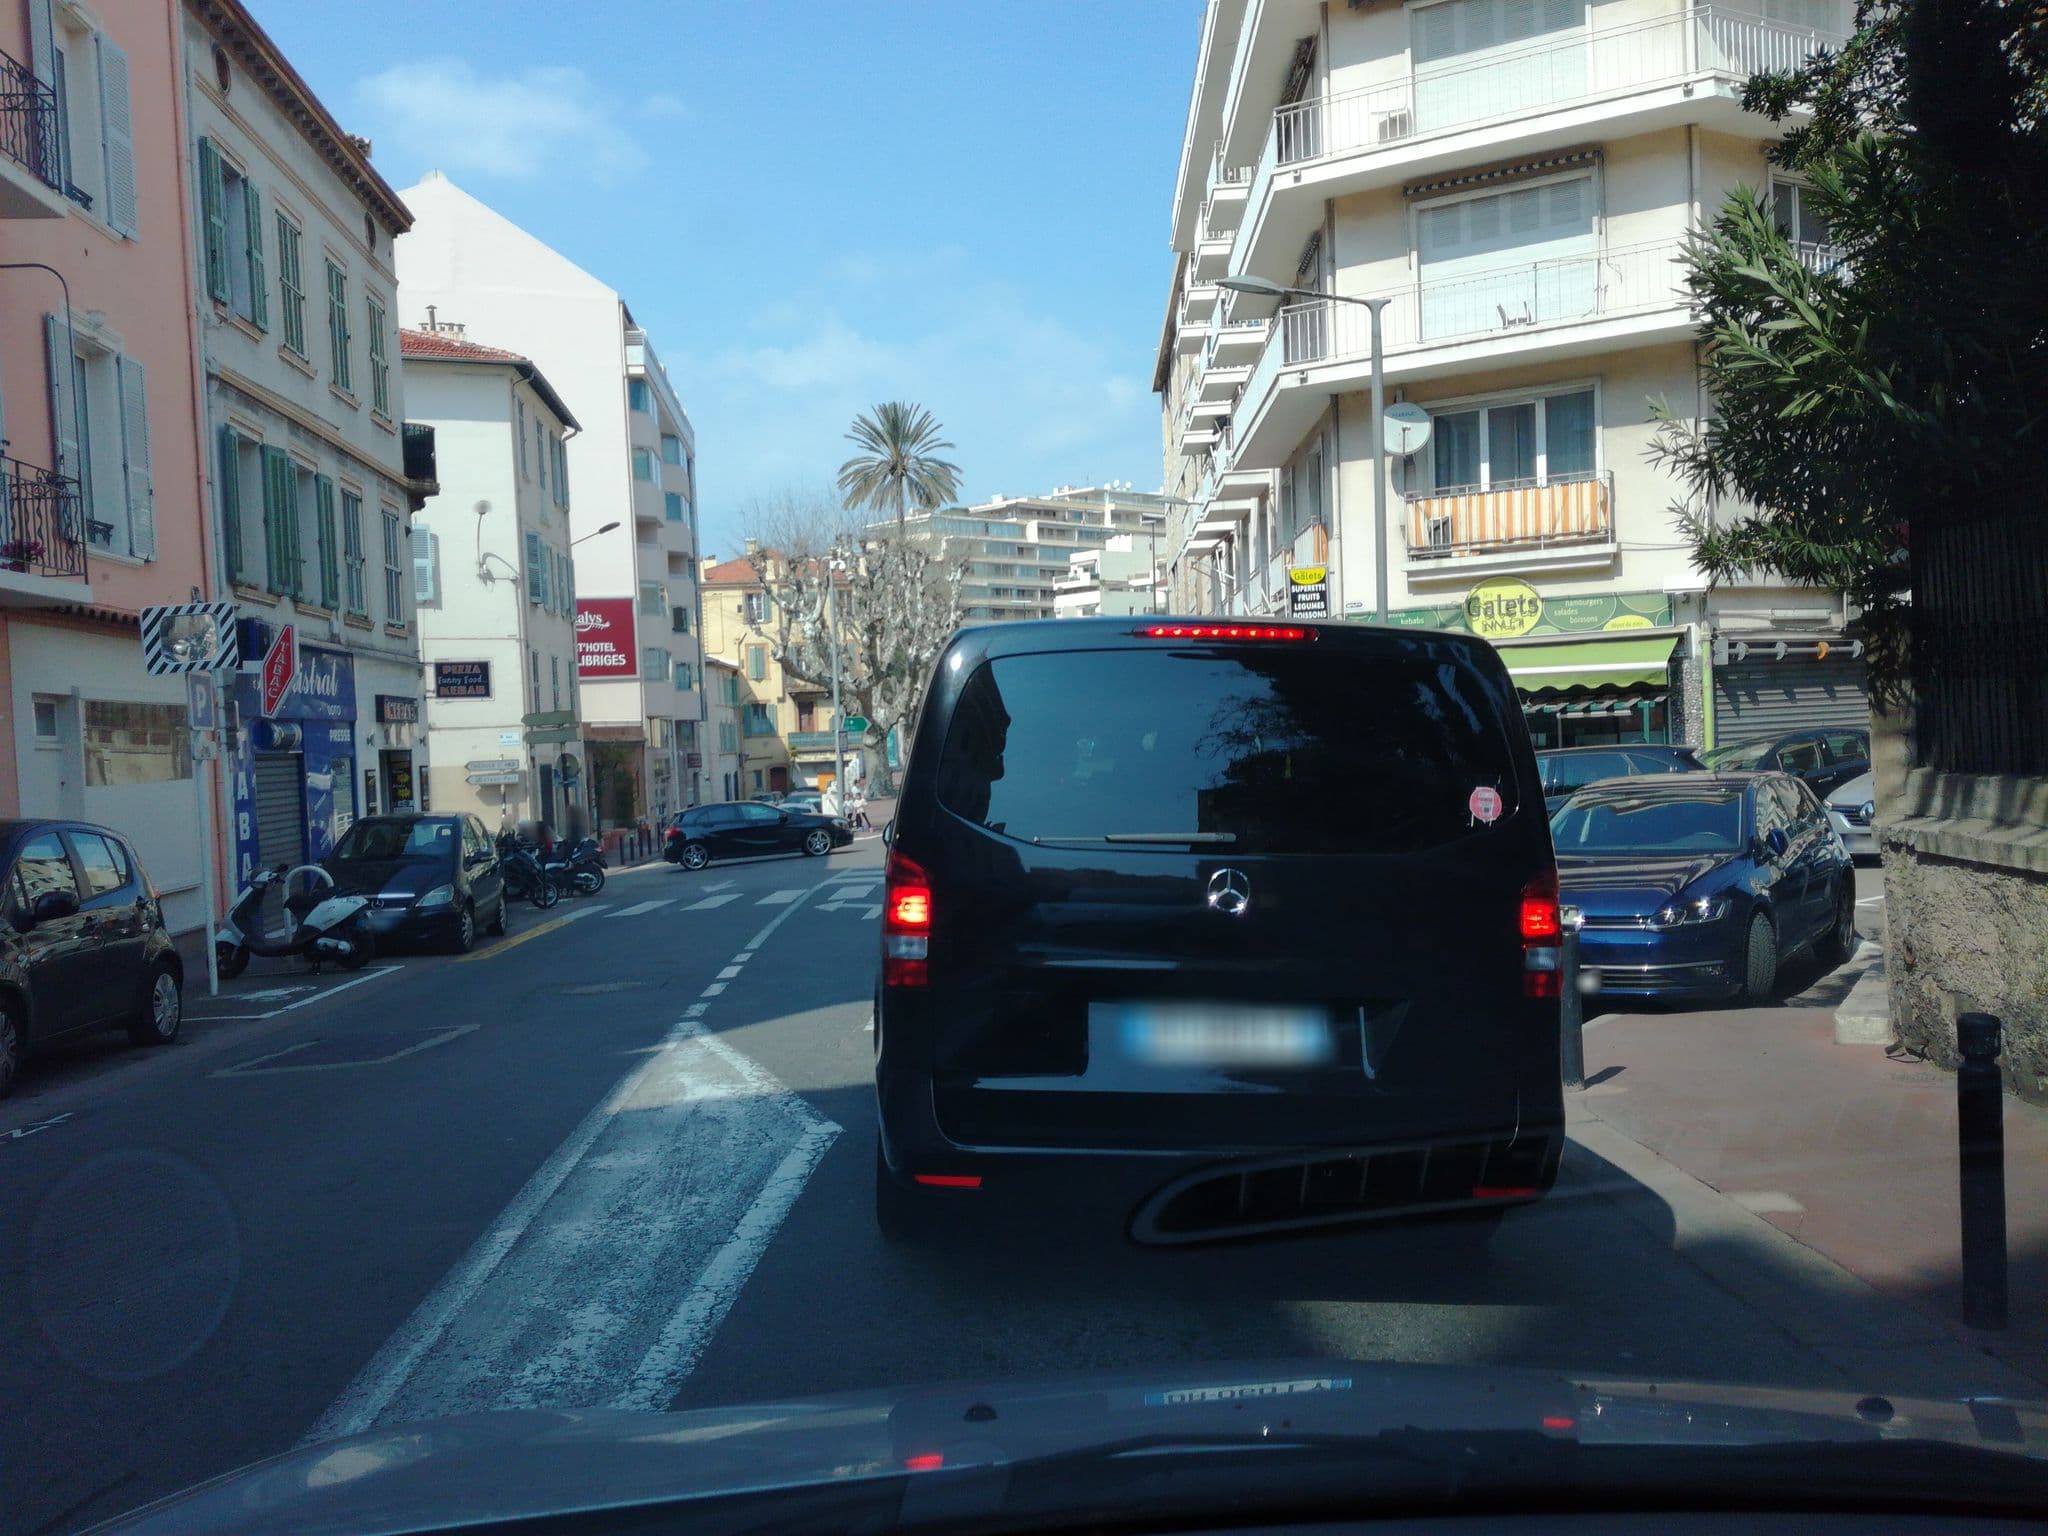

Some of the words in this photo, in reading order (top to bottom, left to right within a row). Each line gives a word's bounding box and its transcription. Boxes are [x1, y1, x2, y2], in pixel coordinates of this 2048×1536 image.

[1291, 584, 1326, 592] SUPERETTE
[1298, 593, 1320, 601] FRUITS
[1294, 601, 1324, 610] LEGUMES
[1467, 594, 1539, 618] Galets
[1565, 599, 1603, 607] hamburgers
[1293, 610, 1327, 619] BOISSONS
[1554, 608, 1578, 616] salades
[577, 611, 603, 630] alys
[1400, 616, 1425, 625] kebabs
[1569, 616, 1598, 624] boissons
[268, 641, 289, 698] TABAC
[442, 665, 481, 674] PIZZA
[293, 657, 339, 697] istral
[329, 729, 351, 742] PRESSE
